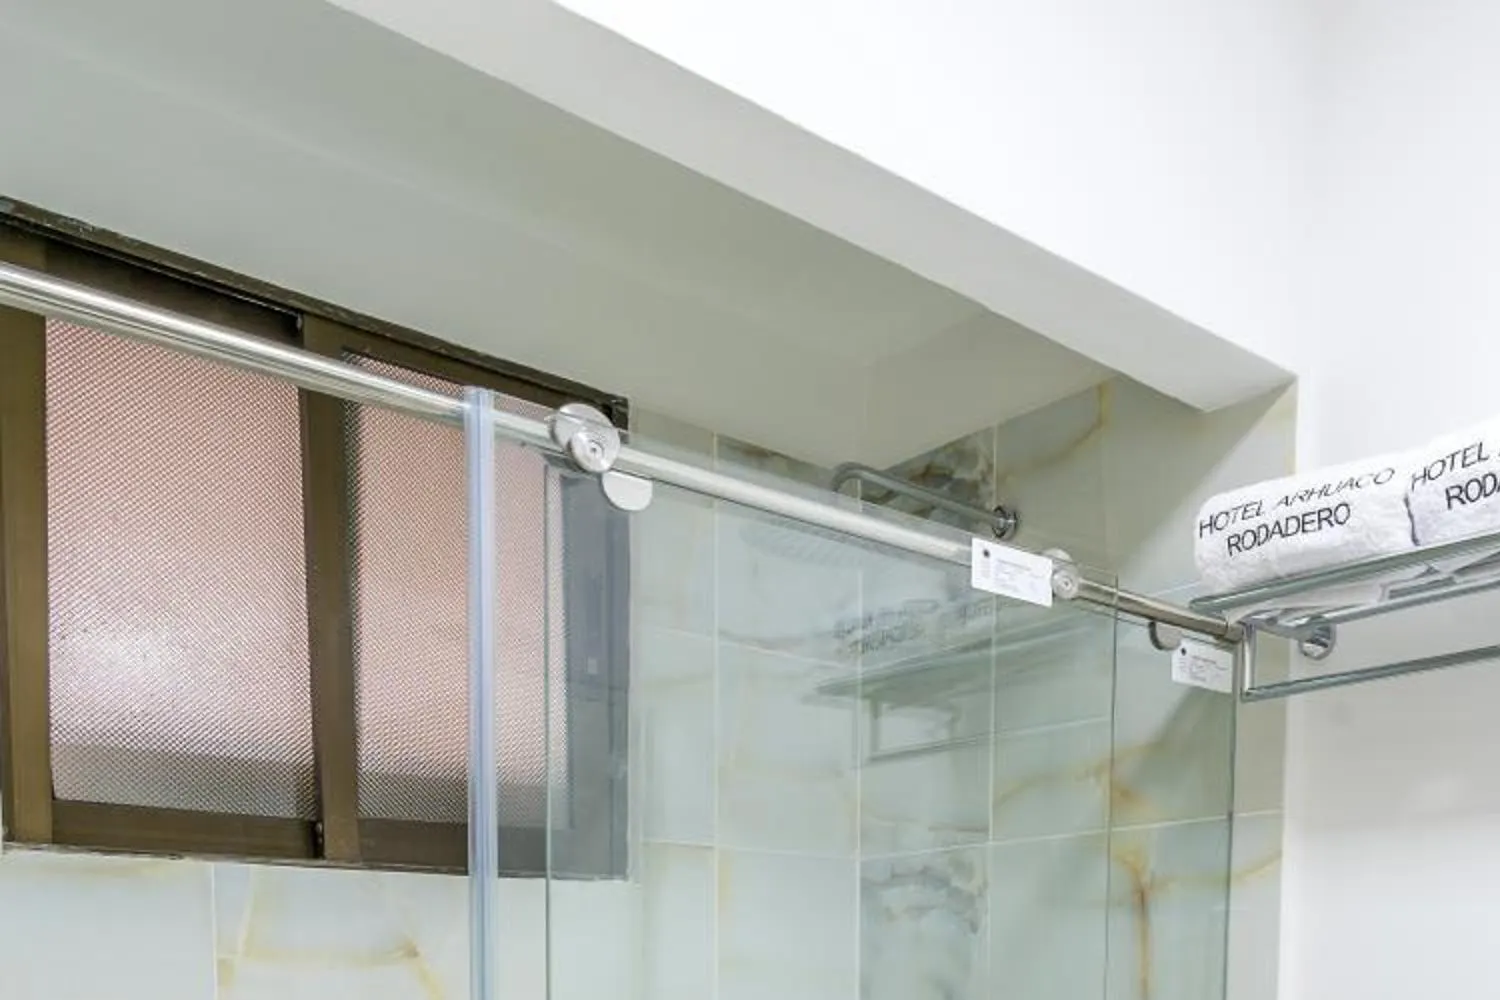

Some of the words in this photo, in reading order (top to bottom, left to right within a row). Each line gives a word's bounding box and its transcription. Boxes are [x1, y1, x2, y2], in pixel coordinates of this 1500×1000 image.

[1411, 442, 1490, 492] HOTEL
[1199, 499, 1264, 539] HOTEL
[1275, 467, 1396, 508] ARHUACO
[1226, 502, 1351, 556] RODADERO
